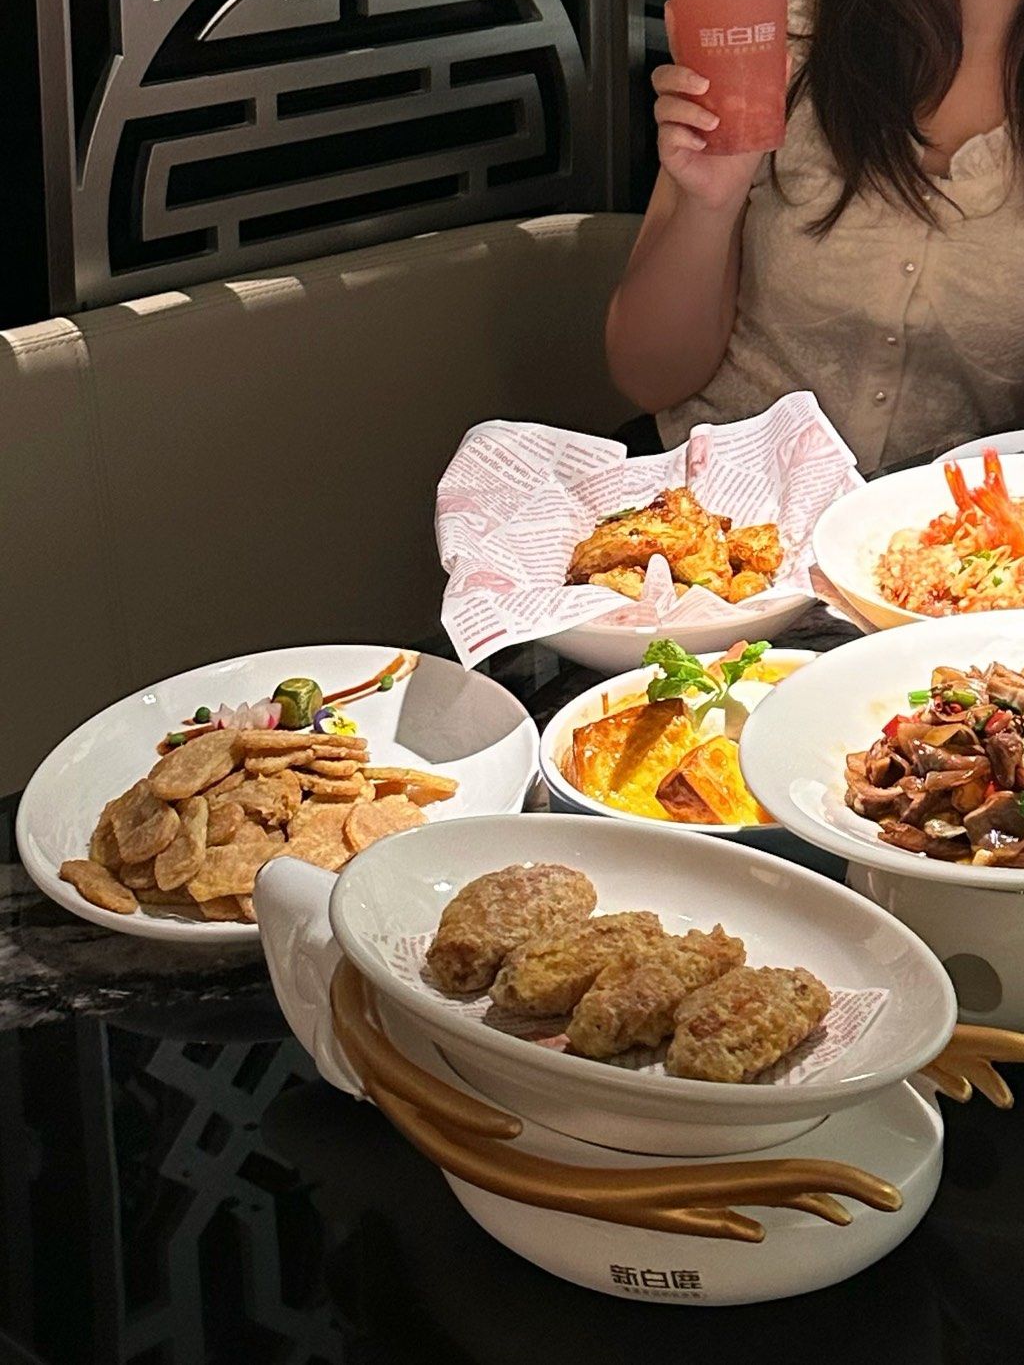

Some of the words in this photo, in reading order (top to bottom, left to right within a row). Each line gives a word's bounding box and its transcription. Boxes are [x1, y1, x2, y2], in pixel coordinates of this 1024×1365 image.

[699, 22, 776, 47] 新白鹿
[466, 444, 503, 472] romantic
[502, 471, 537, 492] country
[610, 1264, 703, 1289] 新白鹿
